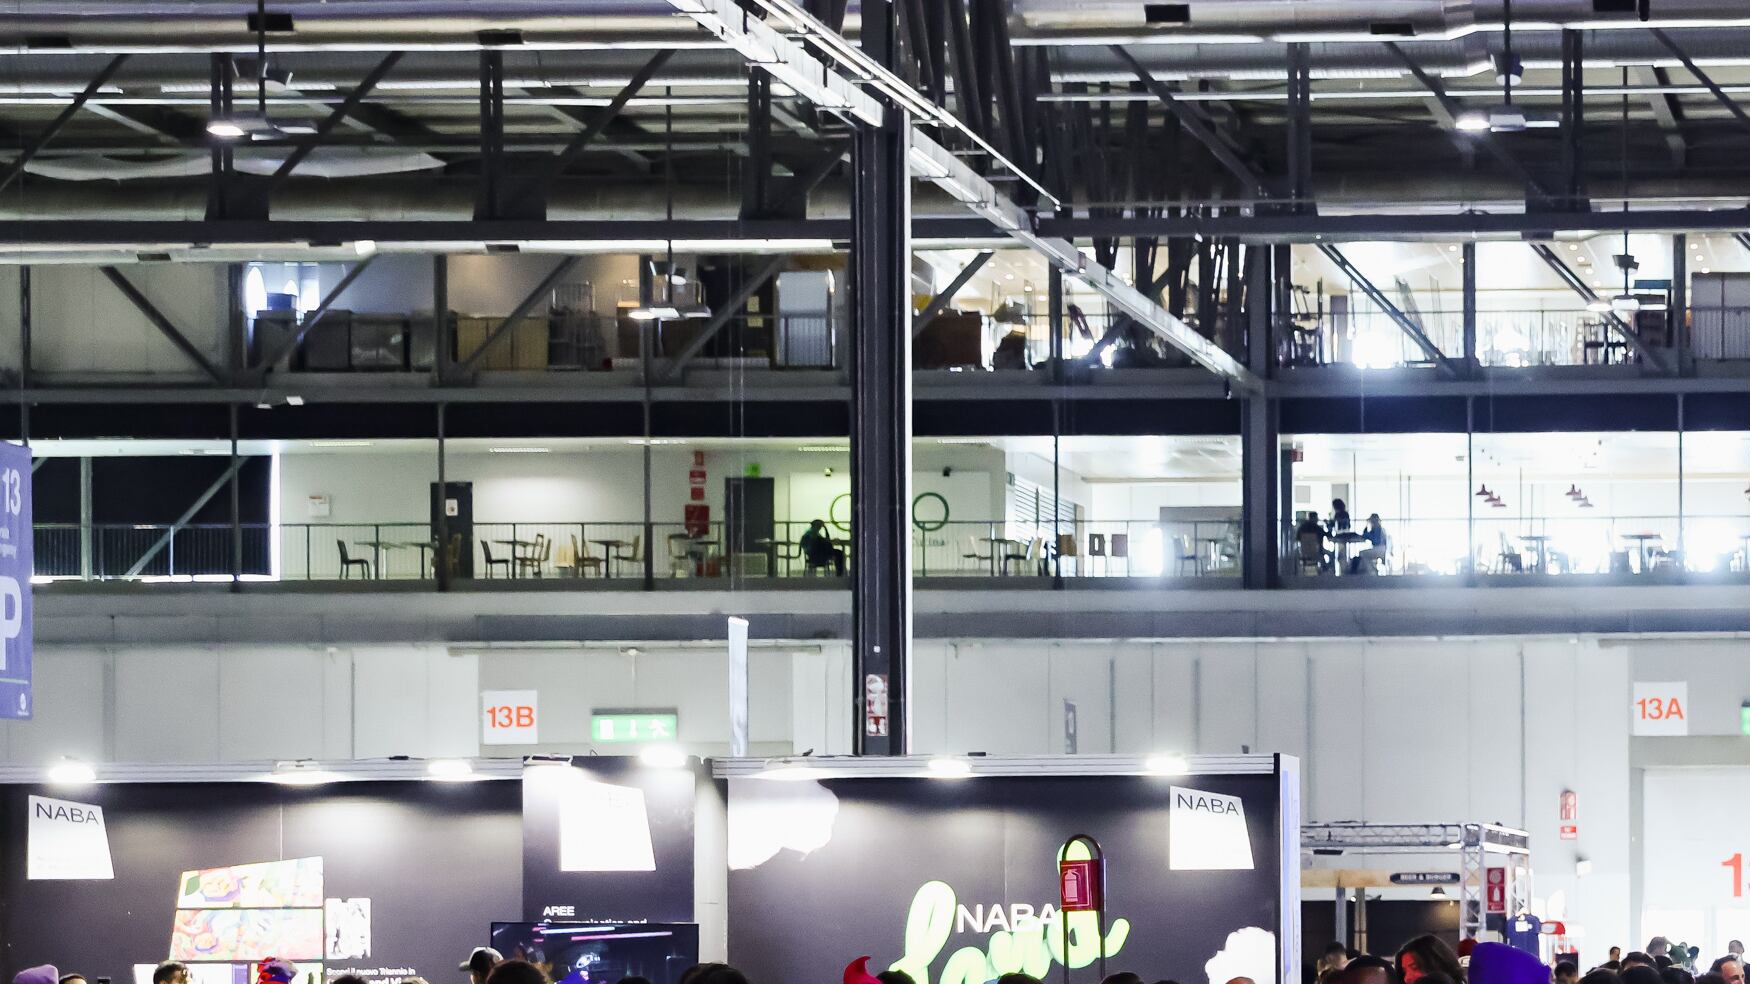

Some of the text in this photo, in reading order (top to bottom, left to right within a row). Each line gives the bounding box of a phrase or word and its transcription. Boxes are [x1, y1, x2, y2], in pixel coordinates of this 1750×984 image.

[2, 467, 21, 516] 13
[486, 706, 535, 728] 13B
[1637, 697, 1684, 720] 13A
[36, 802, 99, 825] NABA
[1177, 793, 1239, 815] NABA
[543, 906, 575, 917] AREE
[956, 903, 1062, 934] NABA
